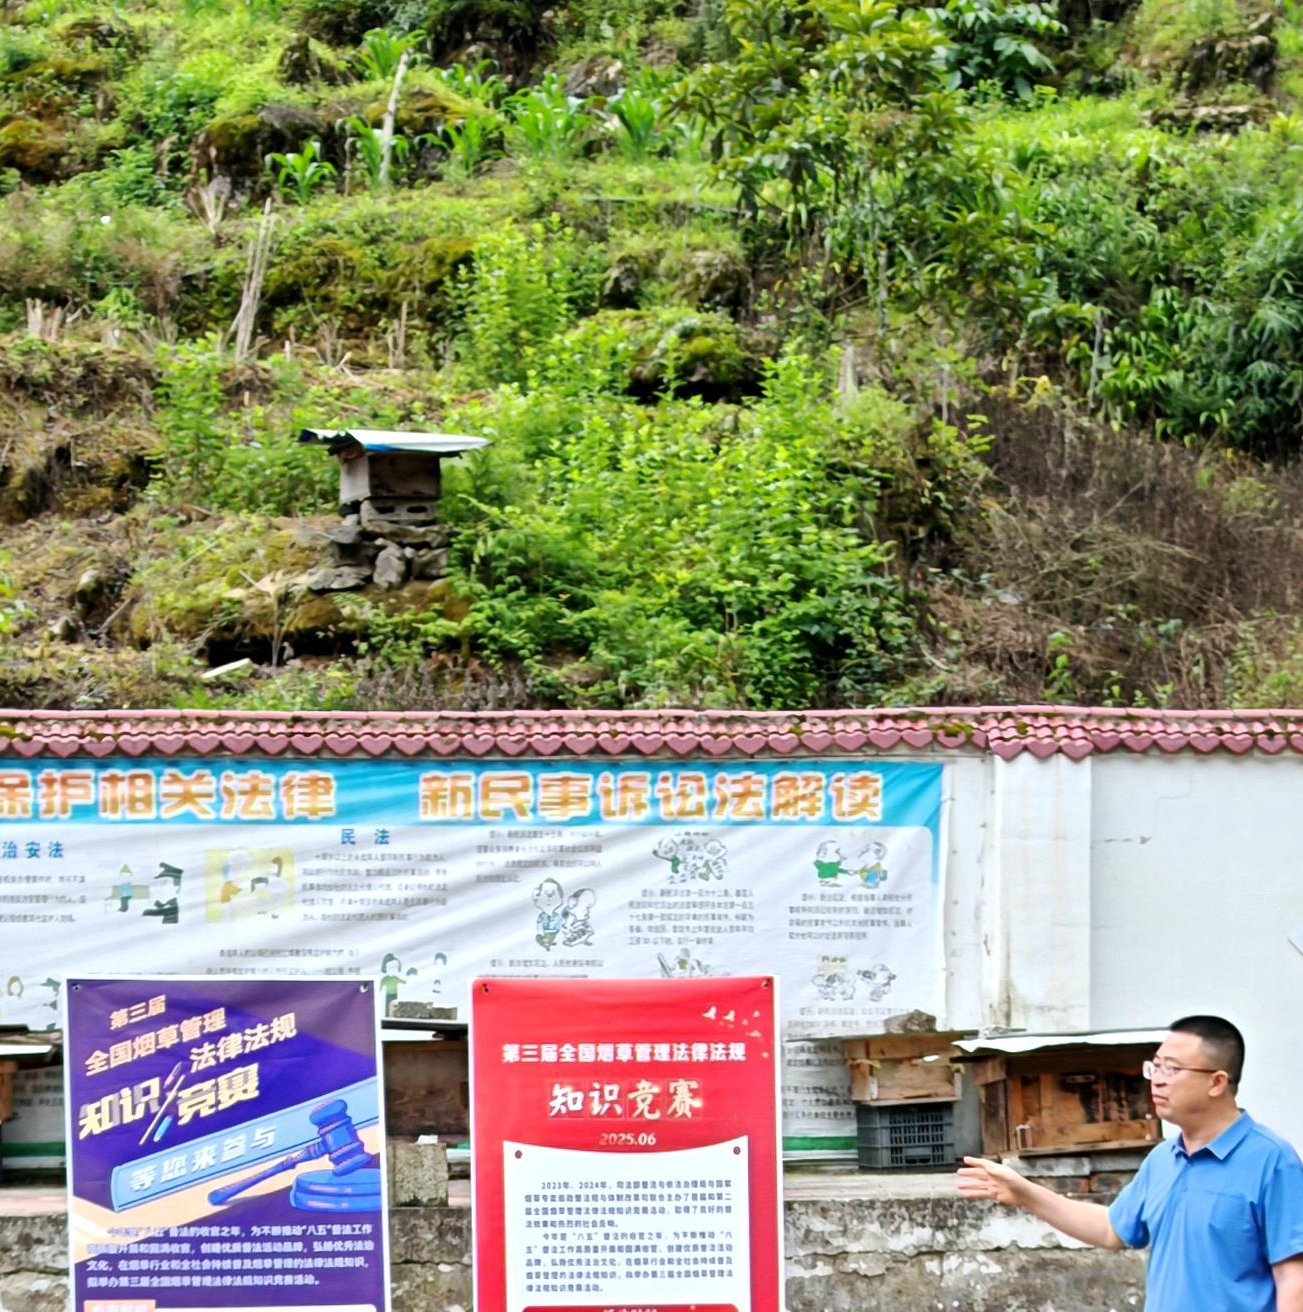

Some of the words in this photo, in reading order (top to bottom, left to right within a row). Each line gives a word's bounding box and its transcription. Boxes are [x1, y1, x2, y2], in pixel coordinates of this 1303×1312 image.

[418, 771, 884, 822] 新民事诉讼法解读
[2, 840, 63, 859] 治安法
[341, 828, 390, 845] 民法
[109, 995, 166, 1030] 第三届
[85, 1008, 226, 1076] 全国烟草管理
[190, 1013, 297, 1072] 法律法规
[502, 1042, 746, 1063] 第三届全国烟草管理法律法规
[548, 1079, 701, 1120] 知识竞赛
[599, 1132, 656, 1147] 2025.06
[130, 1127, 277, 1191] 等您来参与
